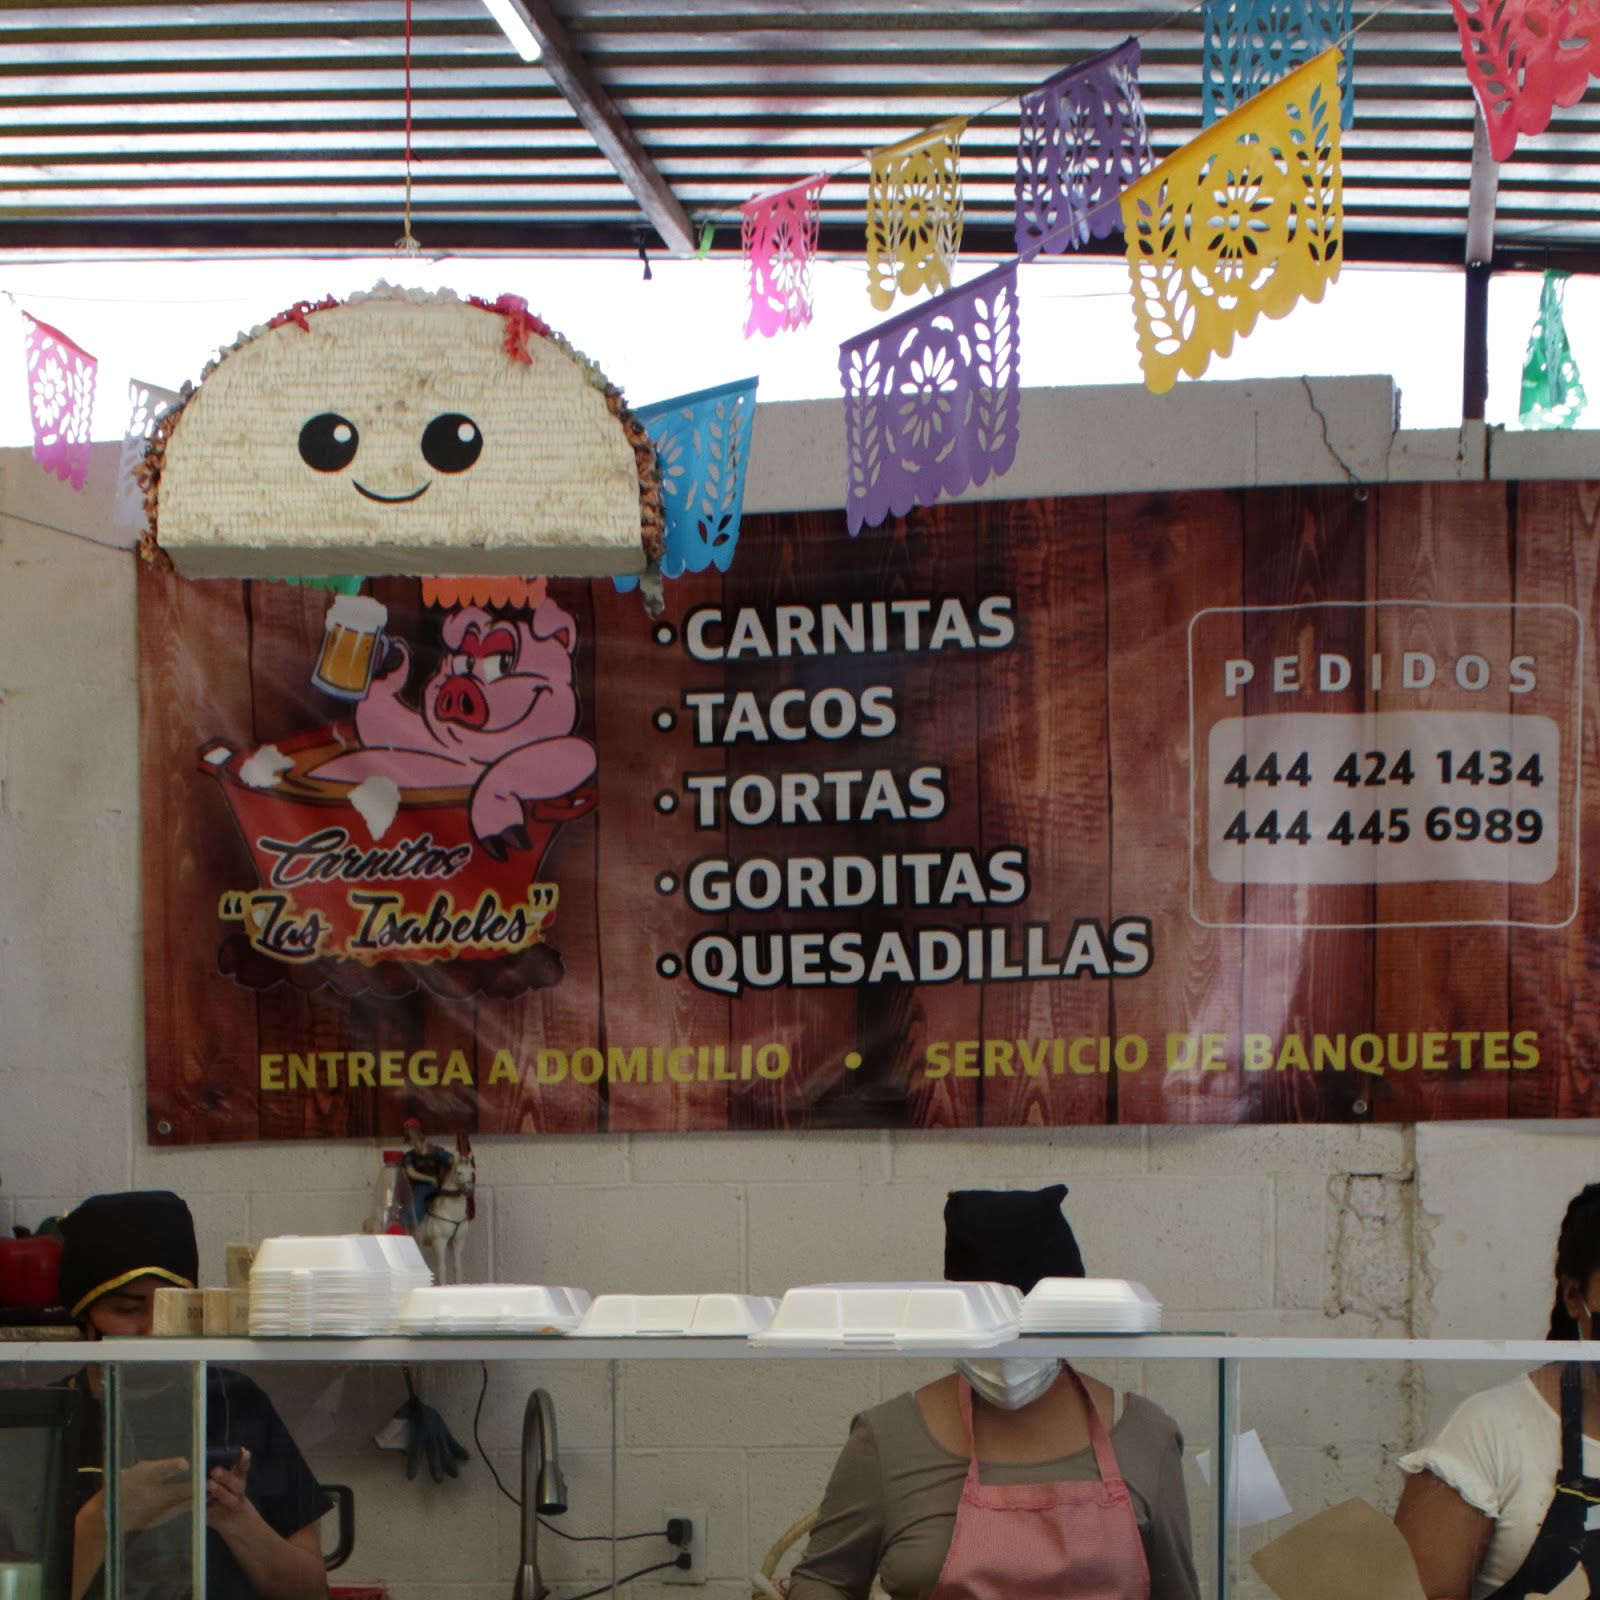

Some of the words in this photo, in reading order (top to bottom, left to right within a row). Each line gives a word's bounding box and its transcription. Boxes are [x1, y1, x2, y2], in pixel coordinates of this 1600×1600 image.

[684, 595, 1017, 663] CARNITAS
[1223, 652, 1538, 697] PEDIDOS
[685, 685, 898, 745] TACOS
[686, 766, 948, 828] TORTAS
[1223, 751, 1312, 789] 444
[1333, 749, 1415, 788] 424
[1436, 748, 1545, 787] 1434
[1223, 808, 1312, 846] 444
[1326, 807, 1411, 846] 445
[1424, 805, 1545, 845] 6989
[256, 827, 471, 887] Carnitas
[688, 849, 1028, 913] GORDITAS
[689, 921, 1152, 996] QUESADILLAS
[259, 1050, 475, 1091] ENTREGA
[488, 1049, 522, 1085] A
[537, 1043, 792, 1084] DOMICILIO
[924, 1034, 1149, 1079] SERVICIO
[1166, 1033, 1227, 1073] DE
[1243, 1030, 1540, 1076] BANQUETES
